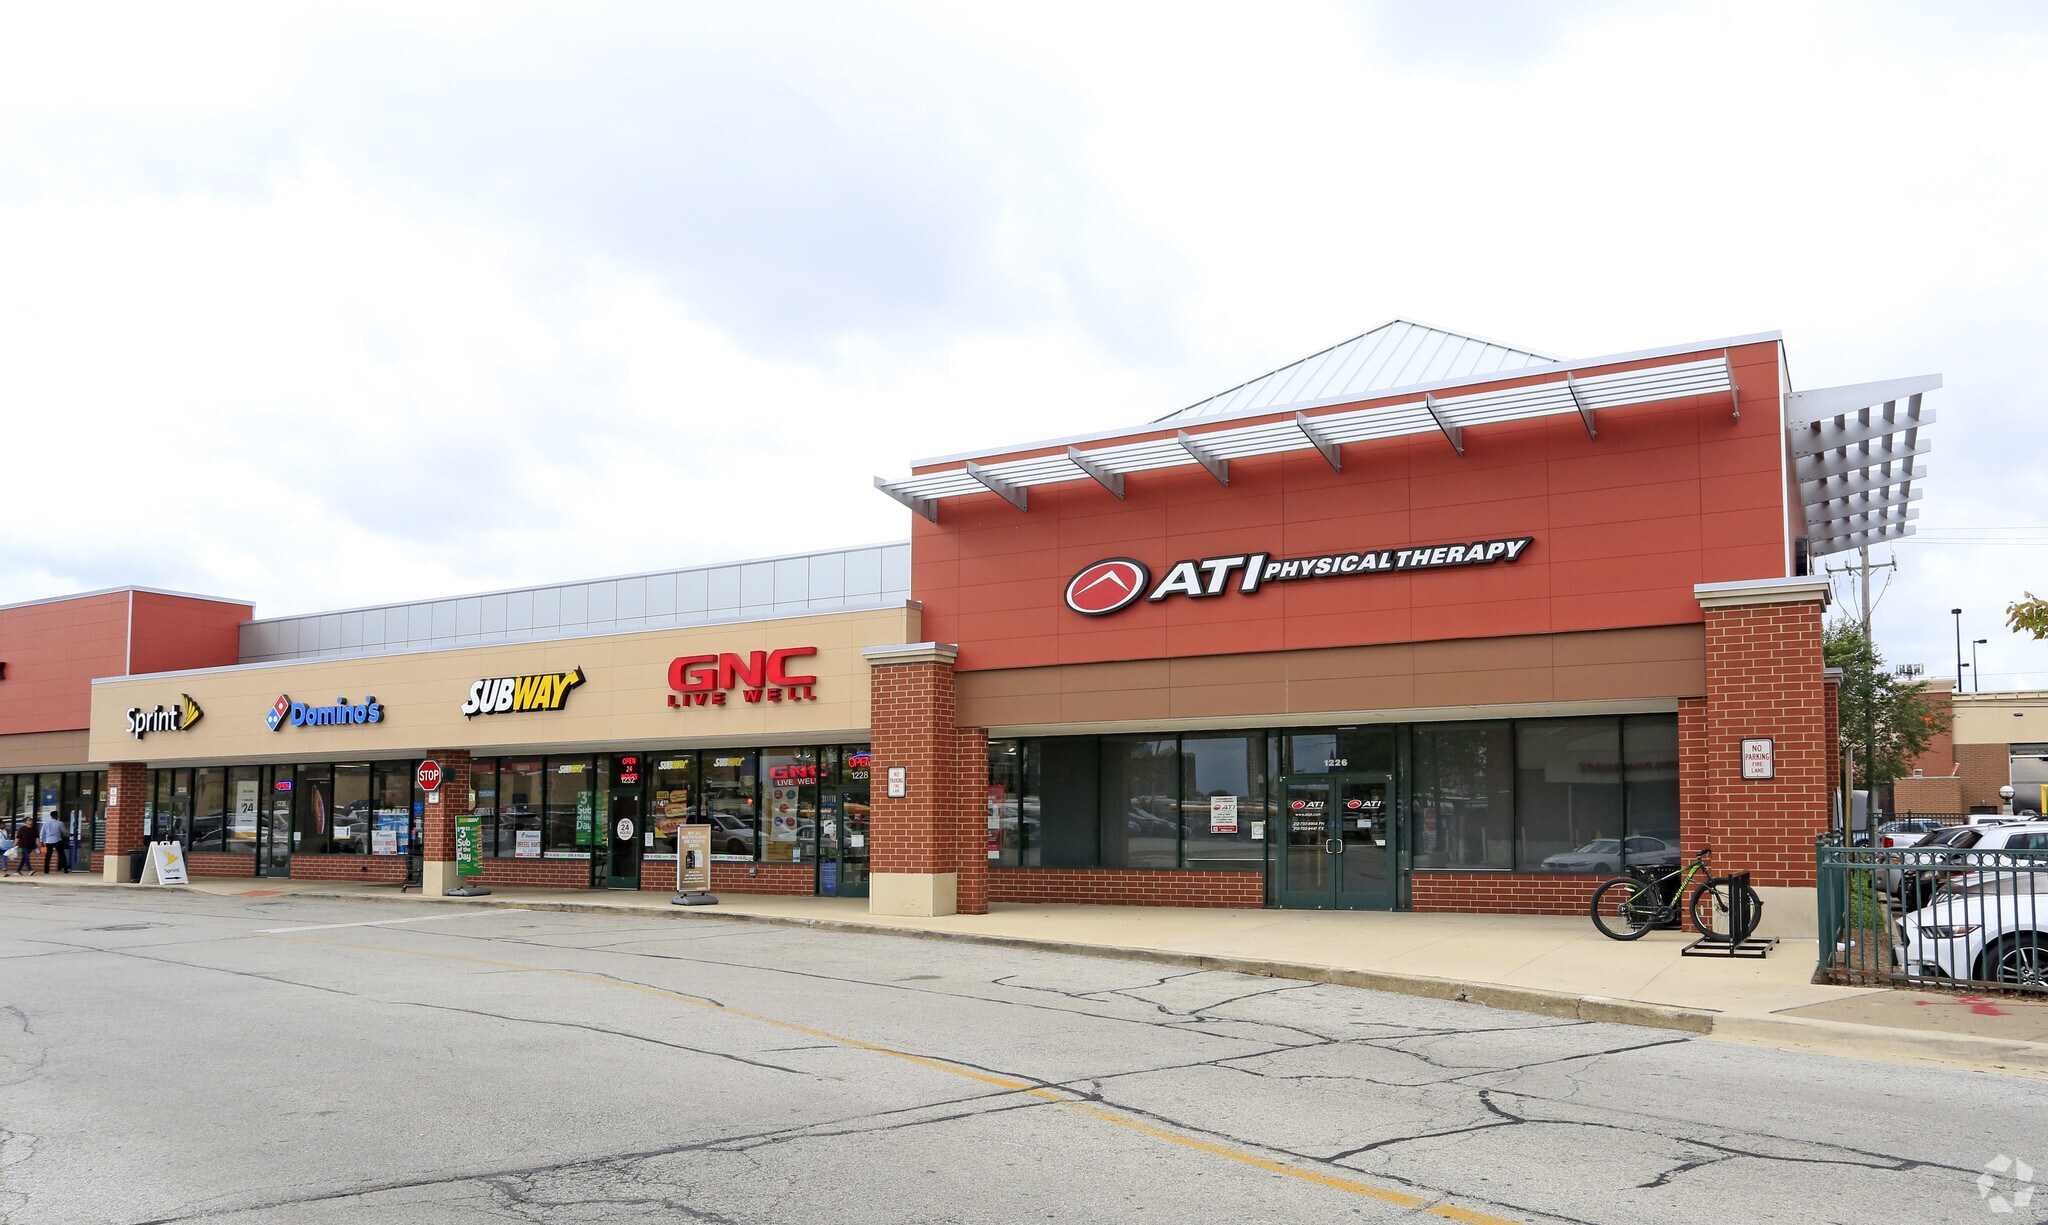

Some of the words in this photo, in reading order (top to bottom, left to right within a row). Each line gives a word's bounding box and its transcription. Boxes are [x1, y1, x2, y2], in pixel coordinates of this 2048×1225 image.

[1149, 553, 1266, 600] ATI
[1263, 550, 1392, 580] PHYSICAL
[1396, 539, 1528, 567] THERAPY
[667, 646, 818, 693] GNC
[460, 668, 584, 717] SUBWAY
[667, 692, 727, 708] LIVE
[744, 684, 818, 704] WELL
[291, 696, 383, 727] Domino's
[125, 704, 181, 740] Sprint
[1752, 744, 1762, 752] NO
[713, 757, 745, 767] SUBWAY
[848, 757, 870, 767] OPEN
[1745, 753, 1770, 761] PARKING
[658, 760, 689, 770] SUBWAY
[1323, 759, 1348, 767] 1226
[558, 763, 586, 774] SUBWAY
[626, 765, 633, 773] 24
[769, 763, 828, 779] GNC
[419, 770, 439, 781] STOP
[851, 771, 869, 780] 1228
[797, 777, 817, 785] WEL
[576, 804, 592, 814] Sub
[576, 820, 592, 832] Day
[457, 838, 471, 847] Sub
[457, 853, 471, 863] Day
